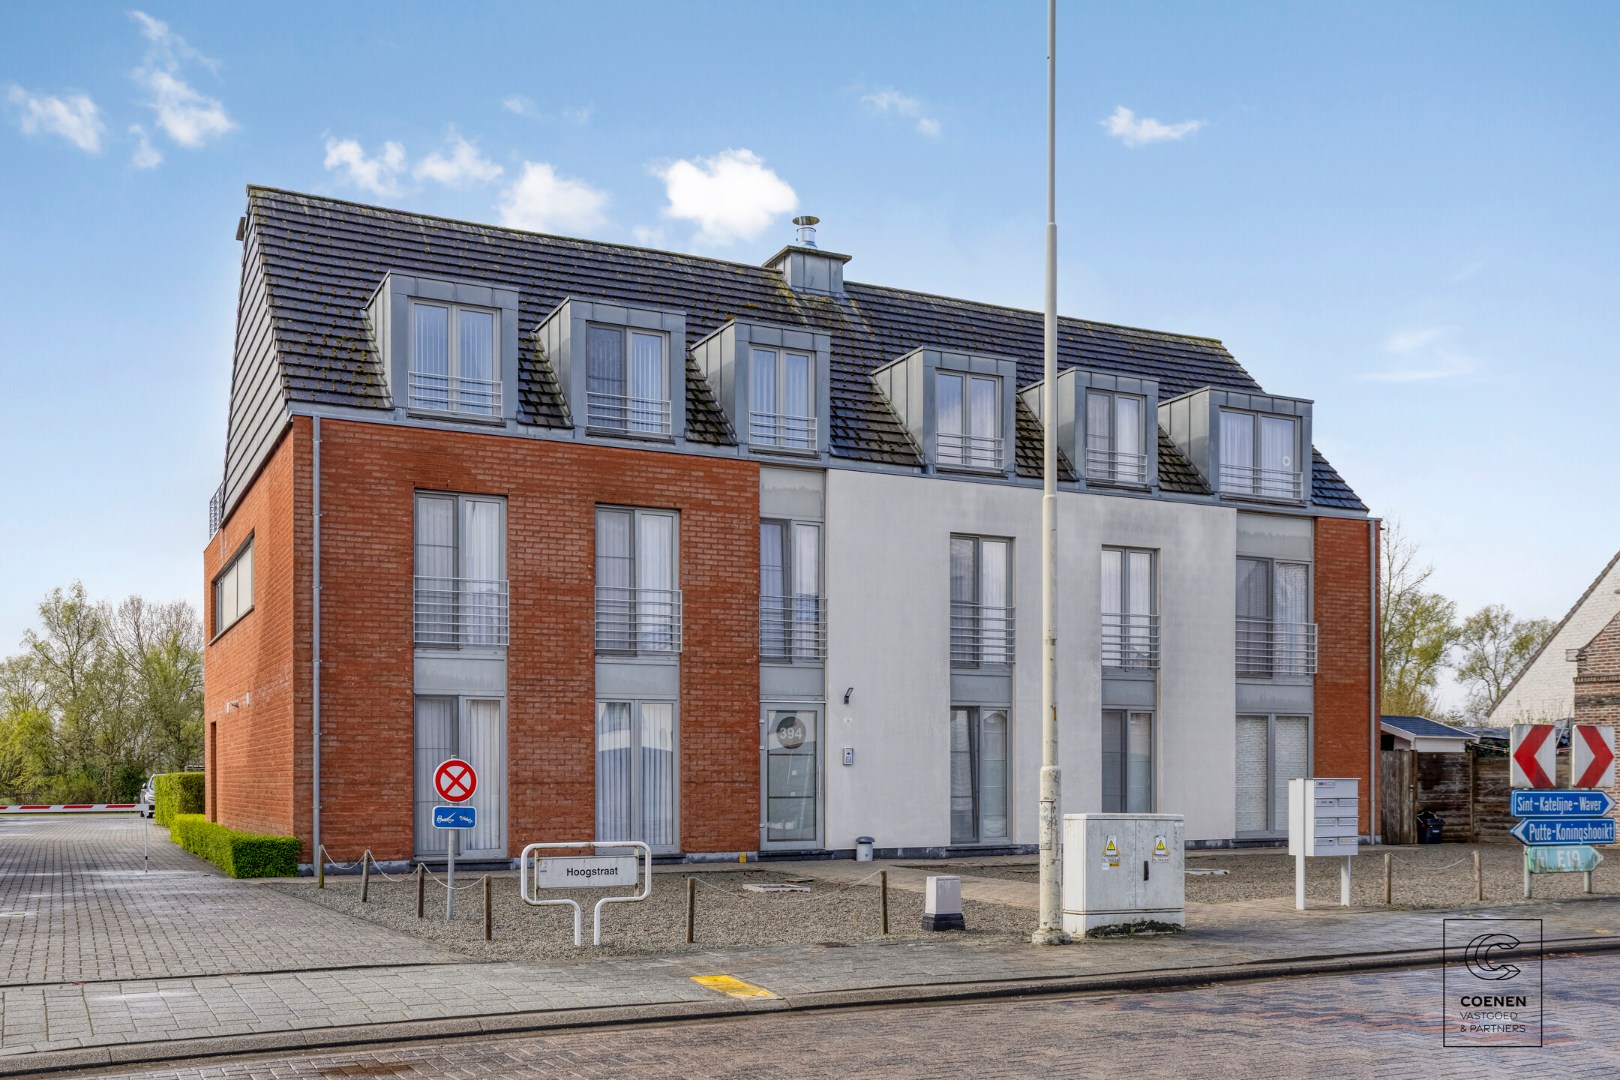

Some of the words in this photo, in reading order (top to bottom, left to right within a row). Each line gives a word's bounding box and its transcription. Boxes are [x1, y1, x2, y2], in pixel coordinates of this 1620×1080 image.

[780, 727, 803, 740] 394
[1529, 823, 1613, 844] Putte-Koningshooikt
[1557, 850, 1581, 867] E19
[566, 866, 619, 878] Hoogstraat
